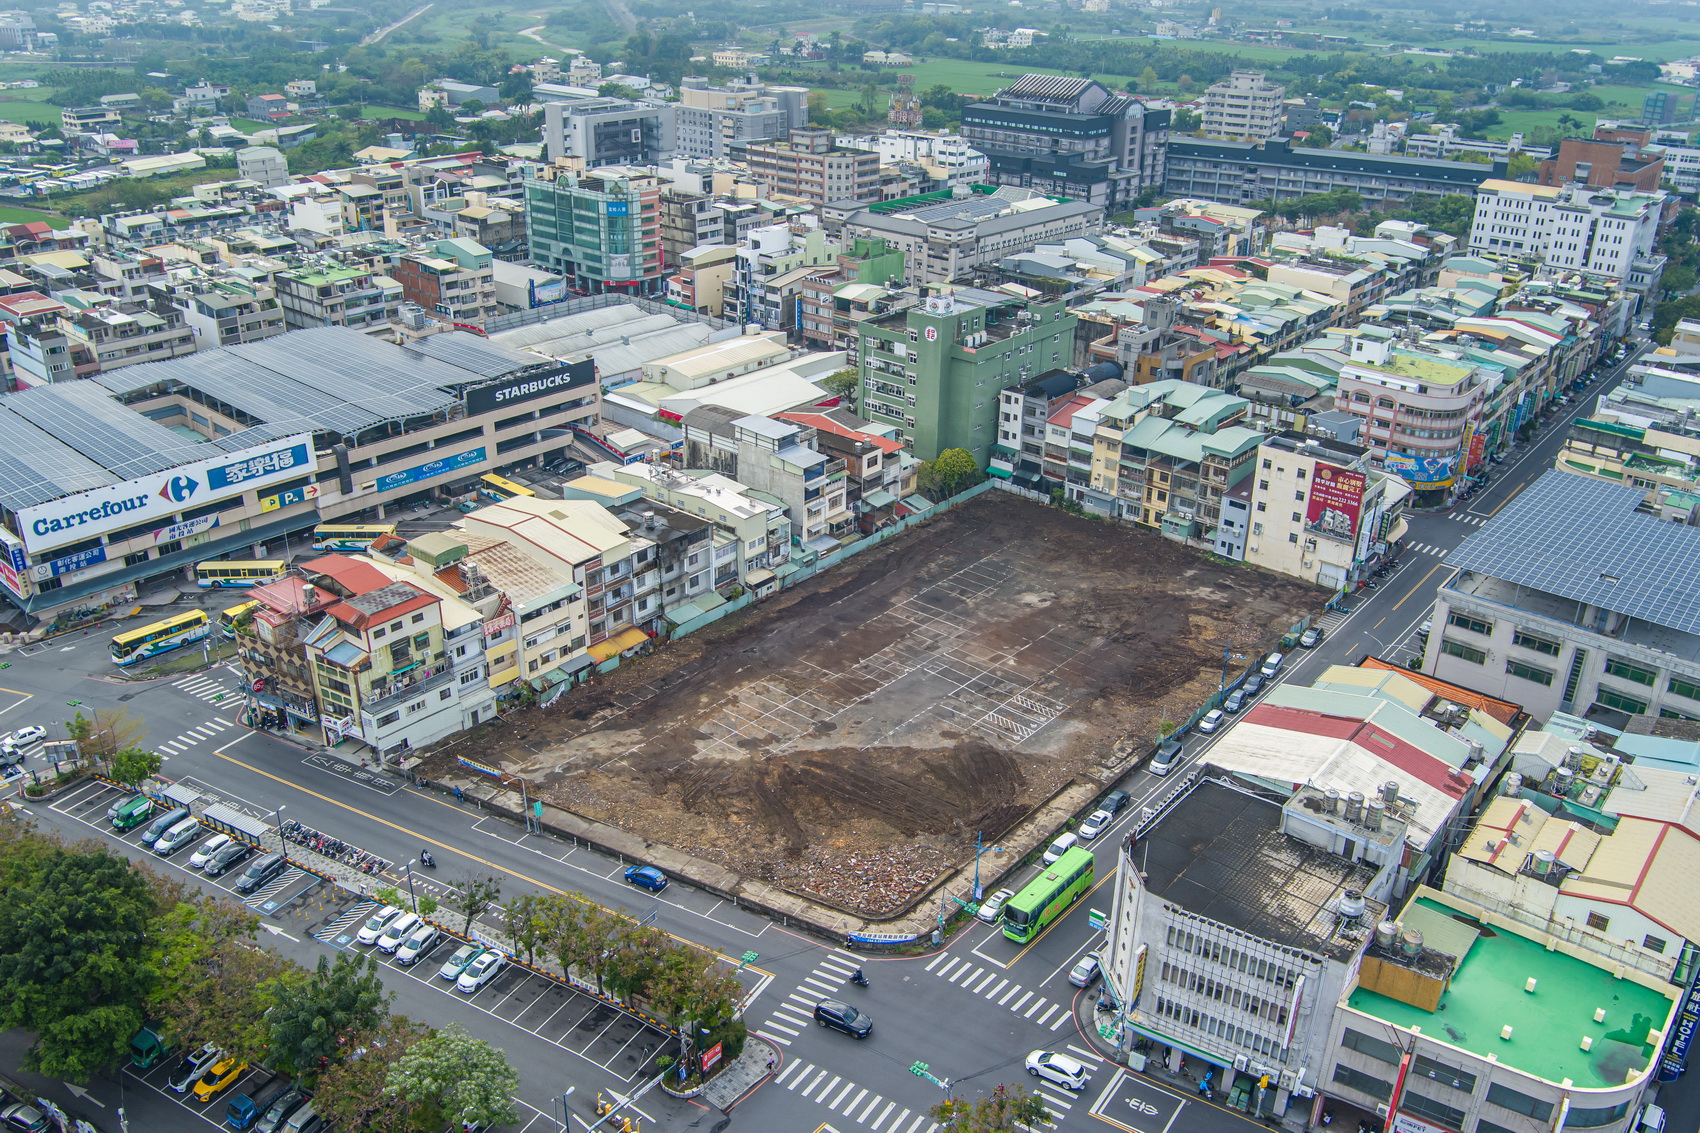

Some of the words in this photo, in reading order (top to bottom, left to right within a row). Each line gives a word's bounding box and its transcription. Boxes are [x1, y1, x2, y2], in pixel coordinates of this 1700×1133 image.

[495, 372, 571, 402] STARBUCKS
[225, 449, 294, 483] 家樂福
[32, 493, 149, 536] Carrefour
[168, 516, 209, 534] 國光客運公司
[57, 549, 100, 567] 彰化客運公司
[1672, 1018, 1694, 1056] HOTEL
